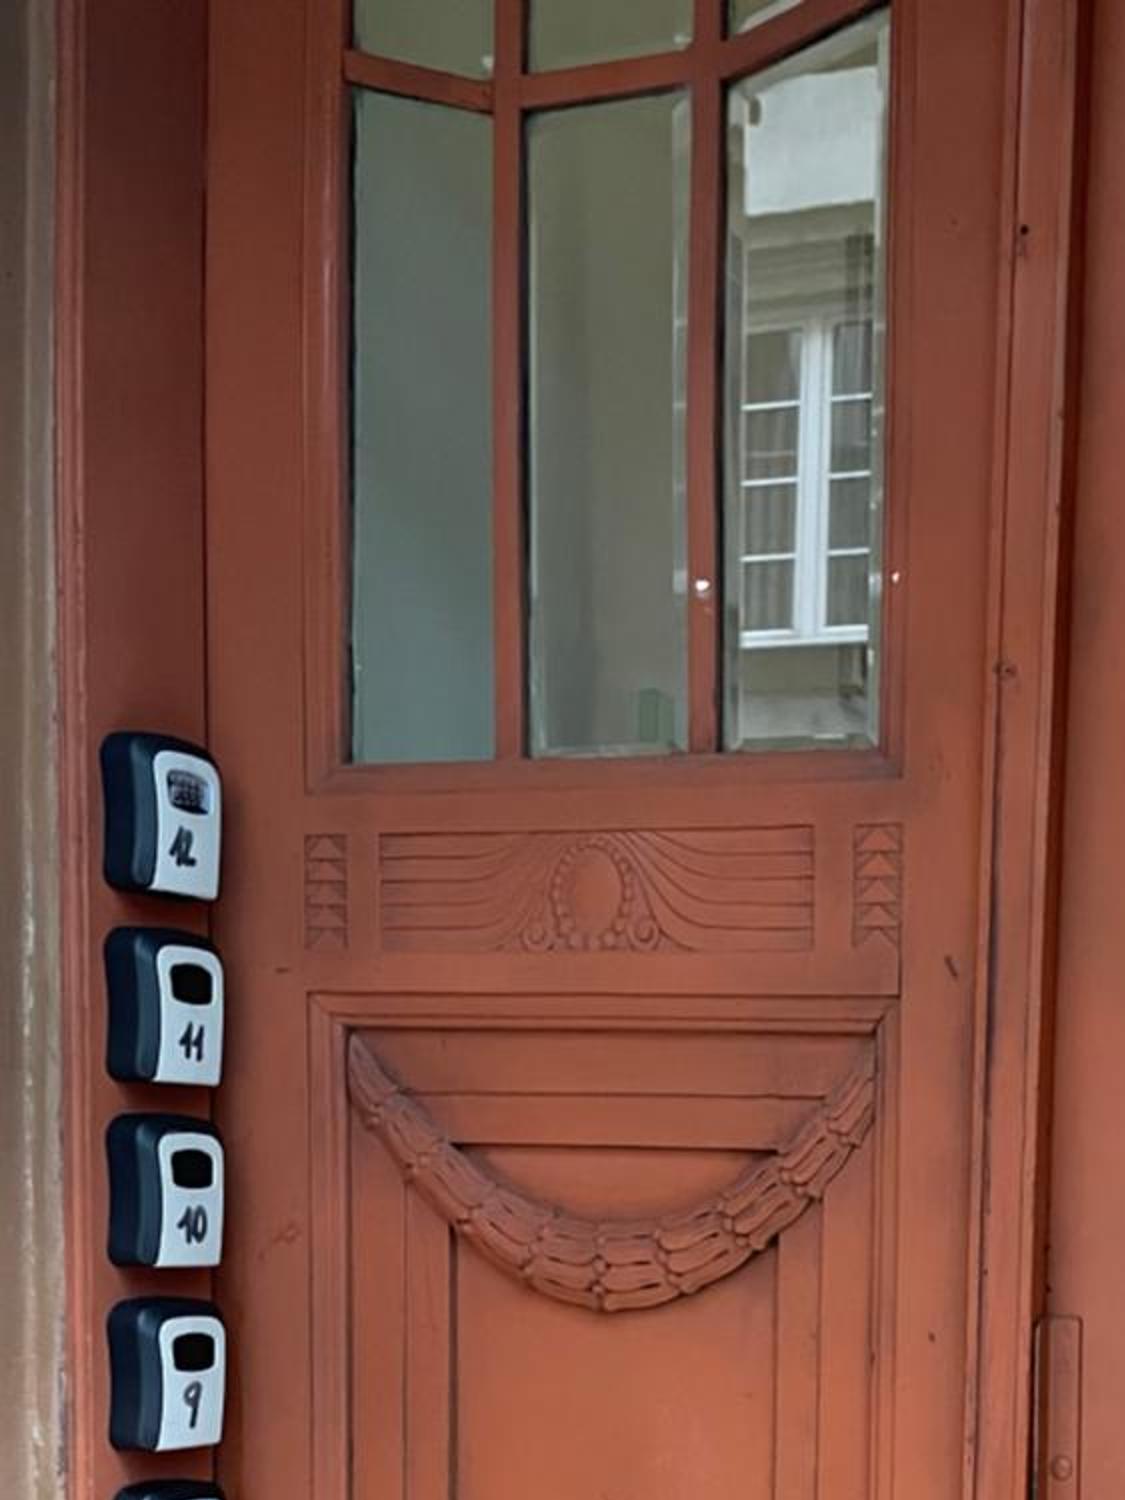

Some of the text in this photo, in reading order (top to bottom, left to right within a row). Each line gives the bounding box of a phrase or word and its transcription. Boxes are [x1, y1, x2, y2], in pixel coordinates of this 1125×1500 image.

[169, 826, 197, 867] 12
[178, 1020, 204, 1062] 11
[177, 1205, 208, 1244] 10
[183, 1380, 203, 1429] 9
